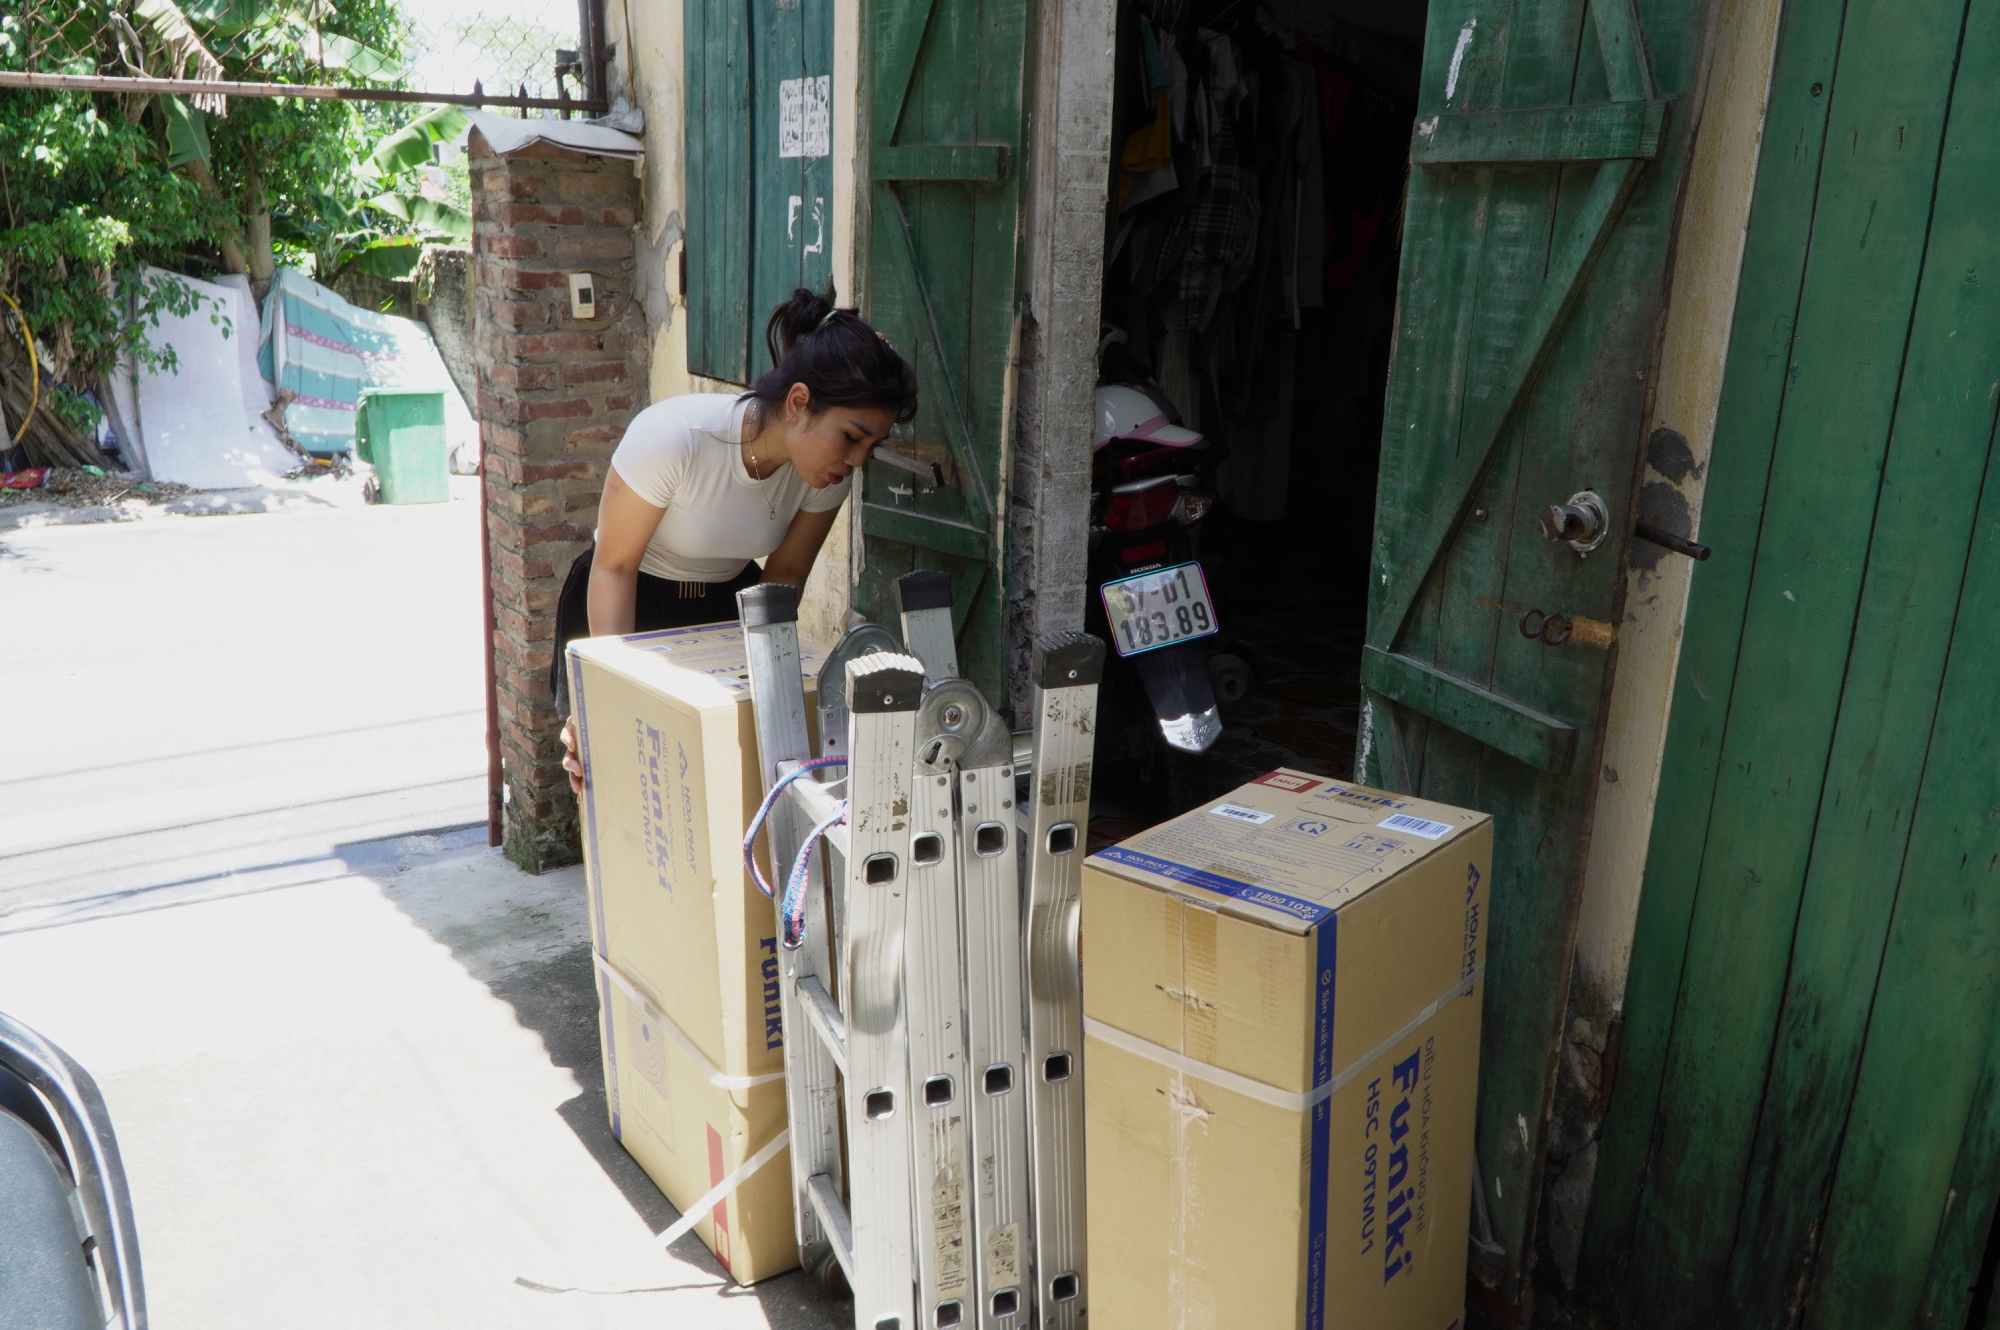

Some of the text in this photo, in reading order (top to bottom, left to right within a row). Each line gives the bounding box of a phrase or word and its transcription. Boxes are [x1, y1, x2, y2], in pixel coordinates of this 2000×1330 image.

[1120, 601, 1210, 649] 183.89
[646, 724, 673, 895] Funiki
[1361, 1077, 1381, 1256] HSC 09TMU1
[1384, 1047, 1421, 1289] Funiki
